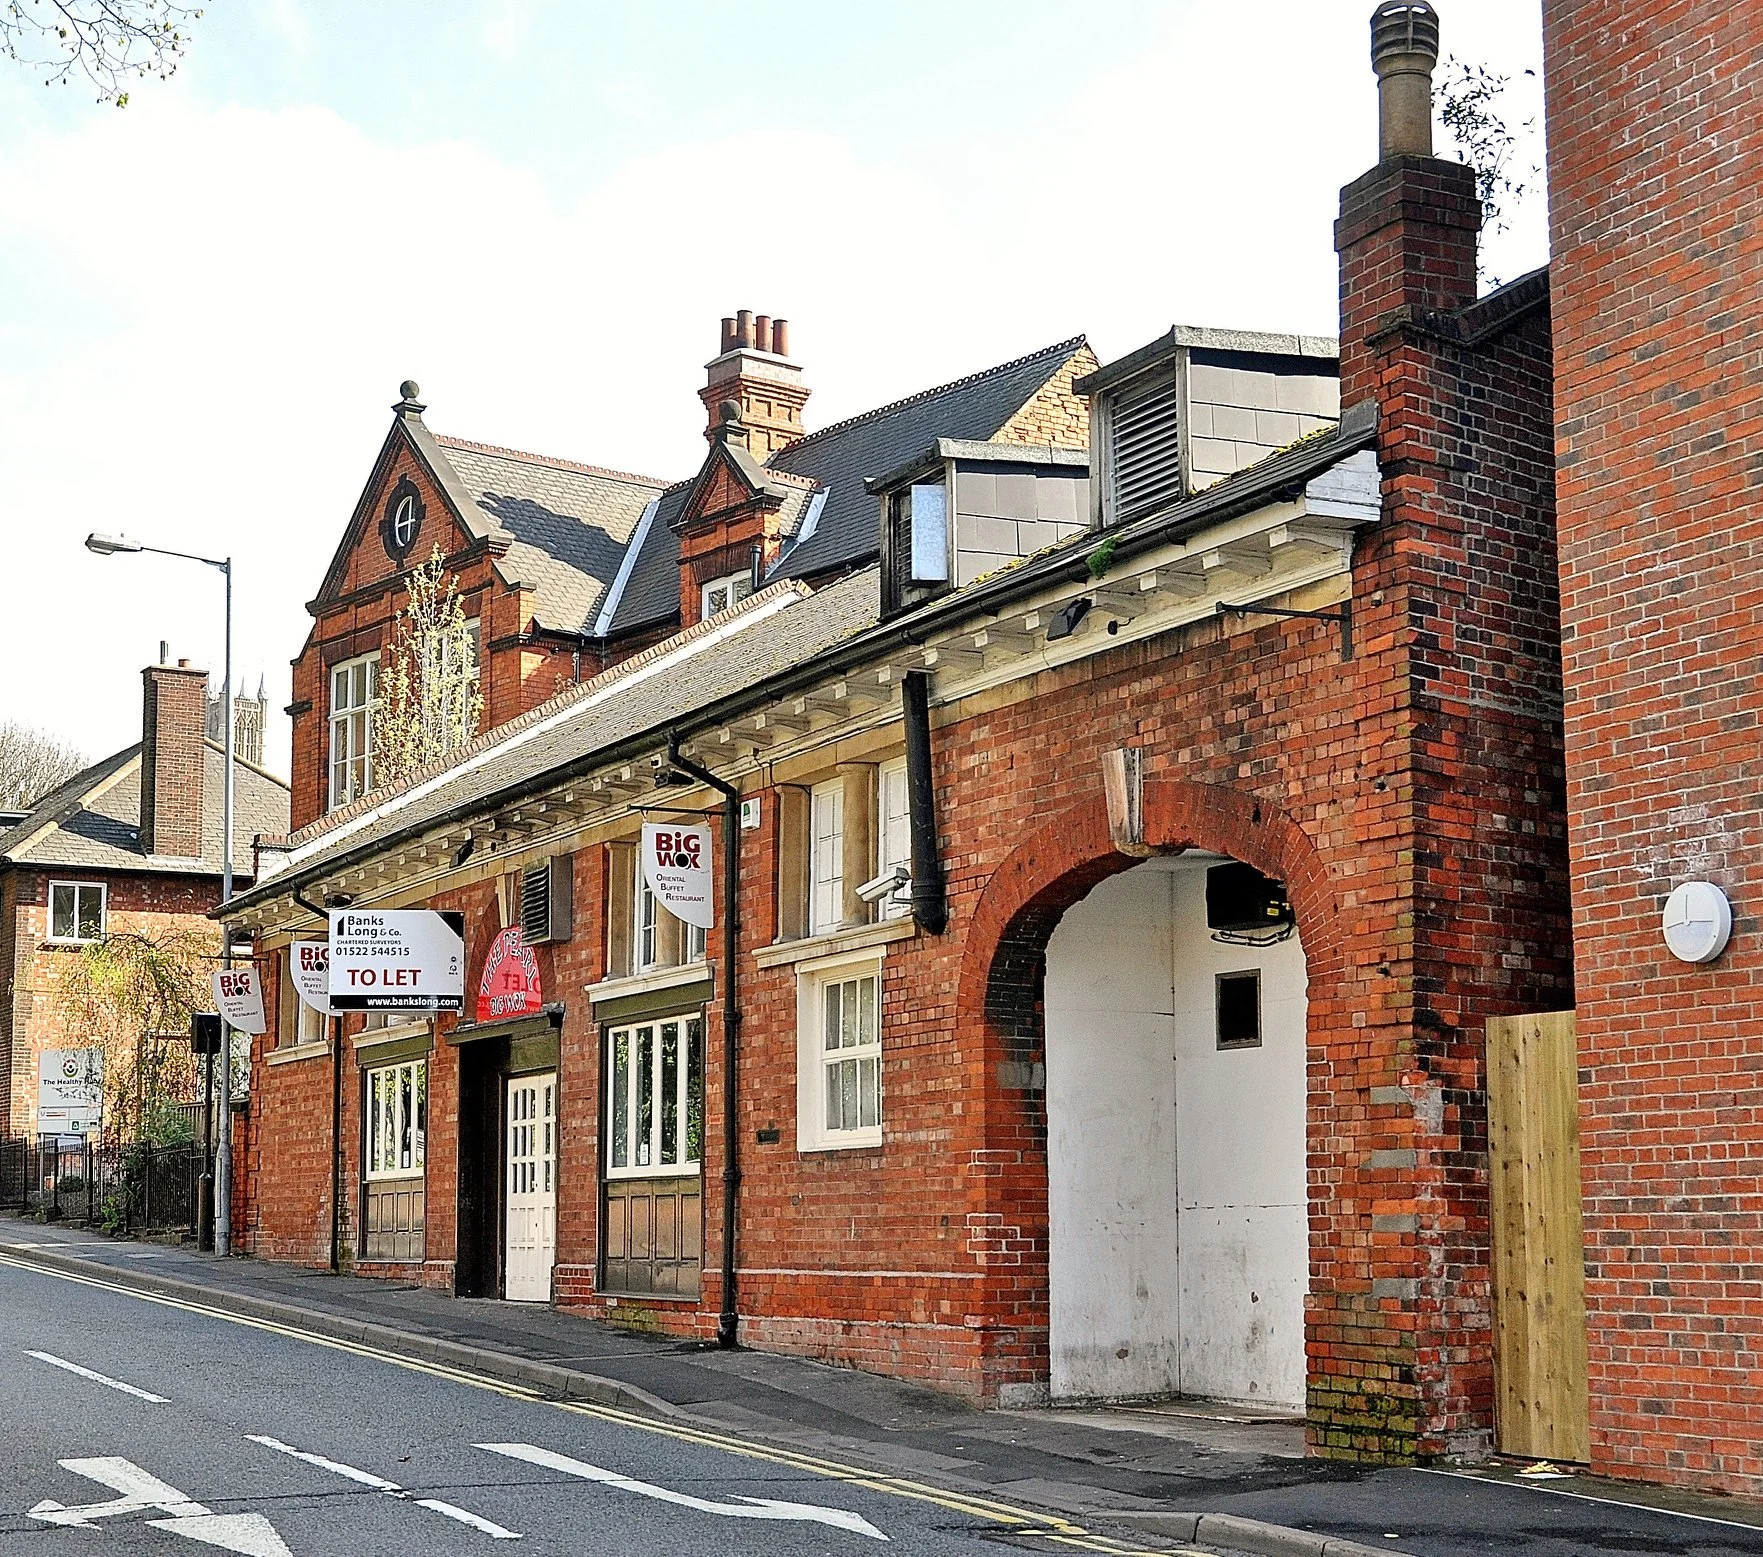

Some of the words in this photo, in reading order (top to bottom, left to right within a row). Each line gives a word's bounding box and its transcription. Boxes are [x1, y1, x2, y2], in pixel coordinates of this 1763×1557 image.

[656, 852, 701, 869] WOK
[347, 915, 384, 926] Banks
[347, 926, 378, 938] Long
[380, 928, 387, 936] &
[388, 928, 402, 936] Co.
[335, 947, 368, 956] 01522
[371, 947, 410, 956] 544515
[347, 969, 377, 986] TO
[383, 969, 421, 986] LET
[221, 985, 252, 998] WOK
[367, 997, 459, 1007] www.bankslong.com
